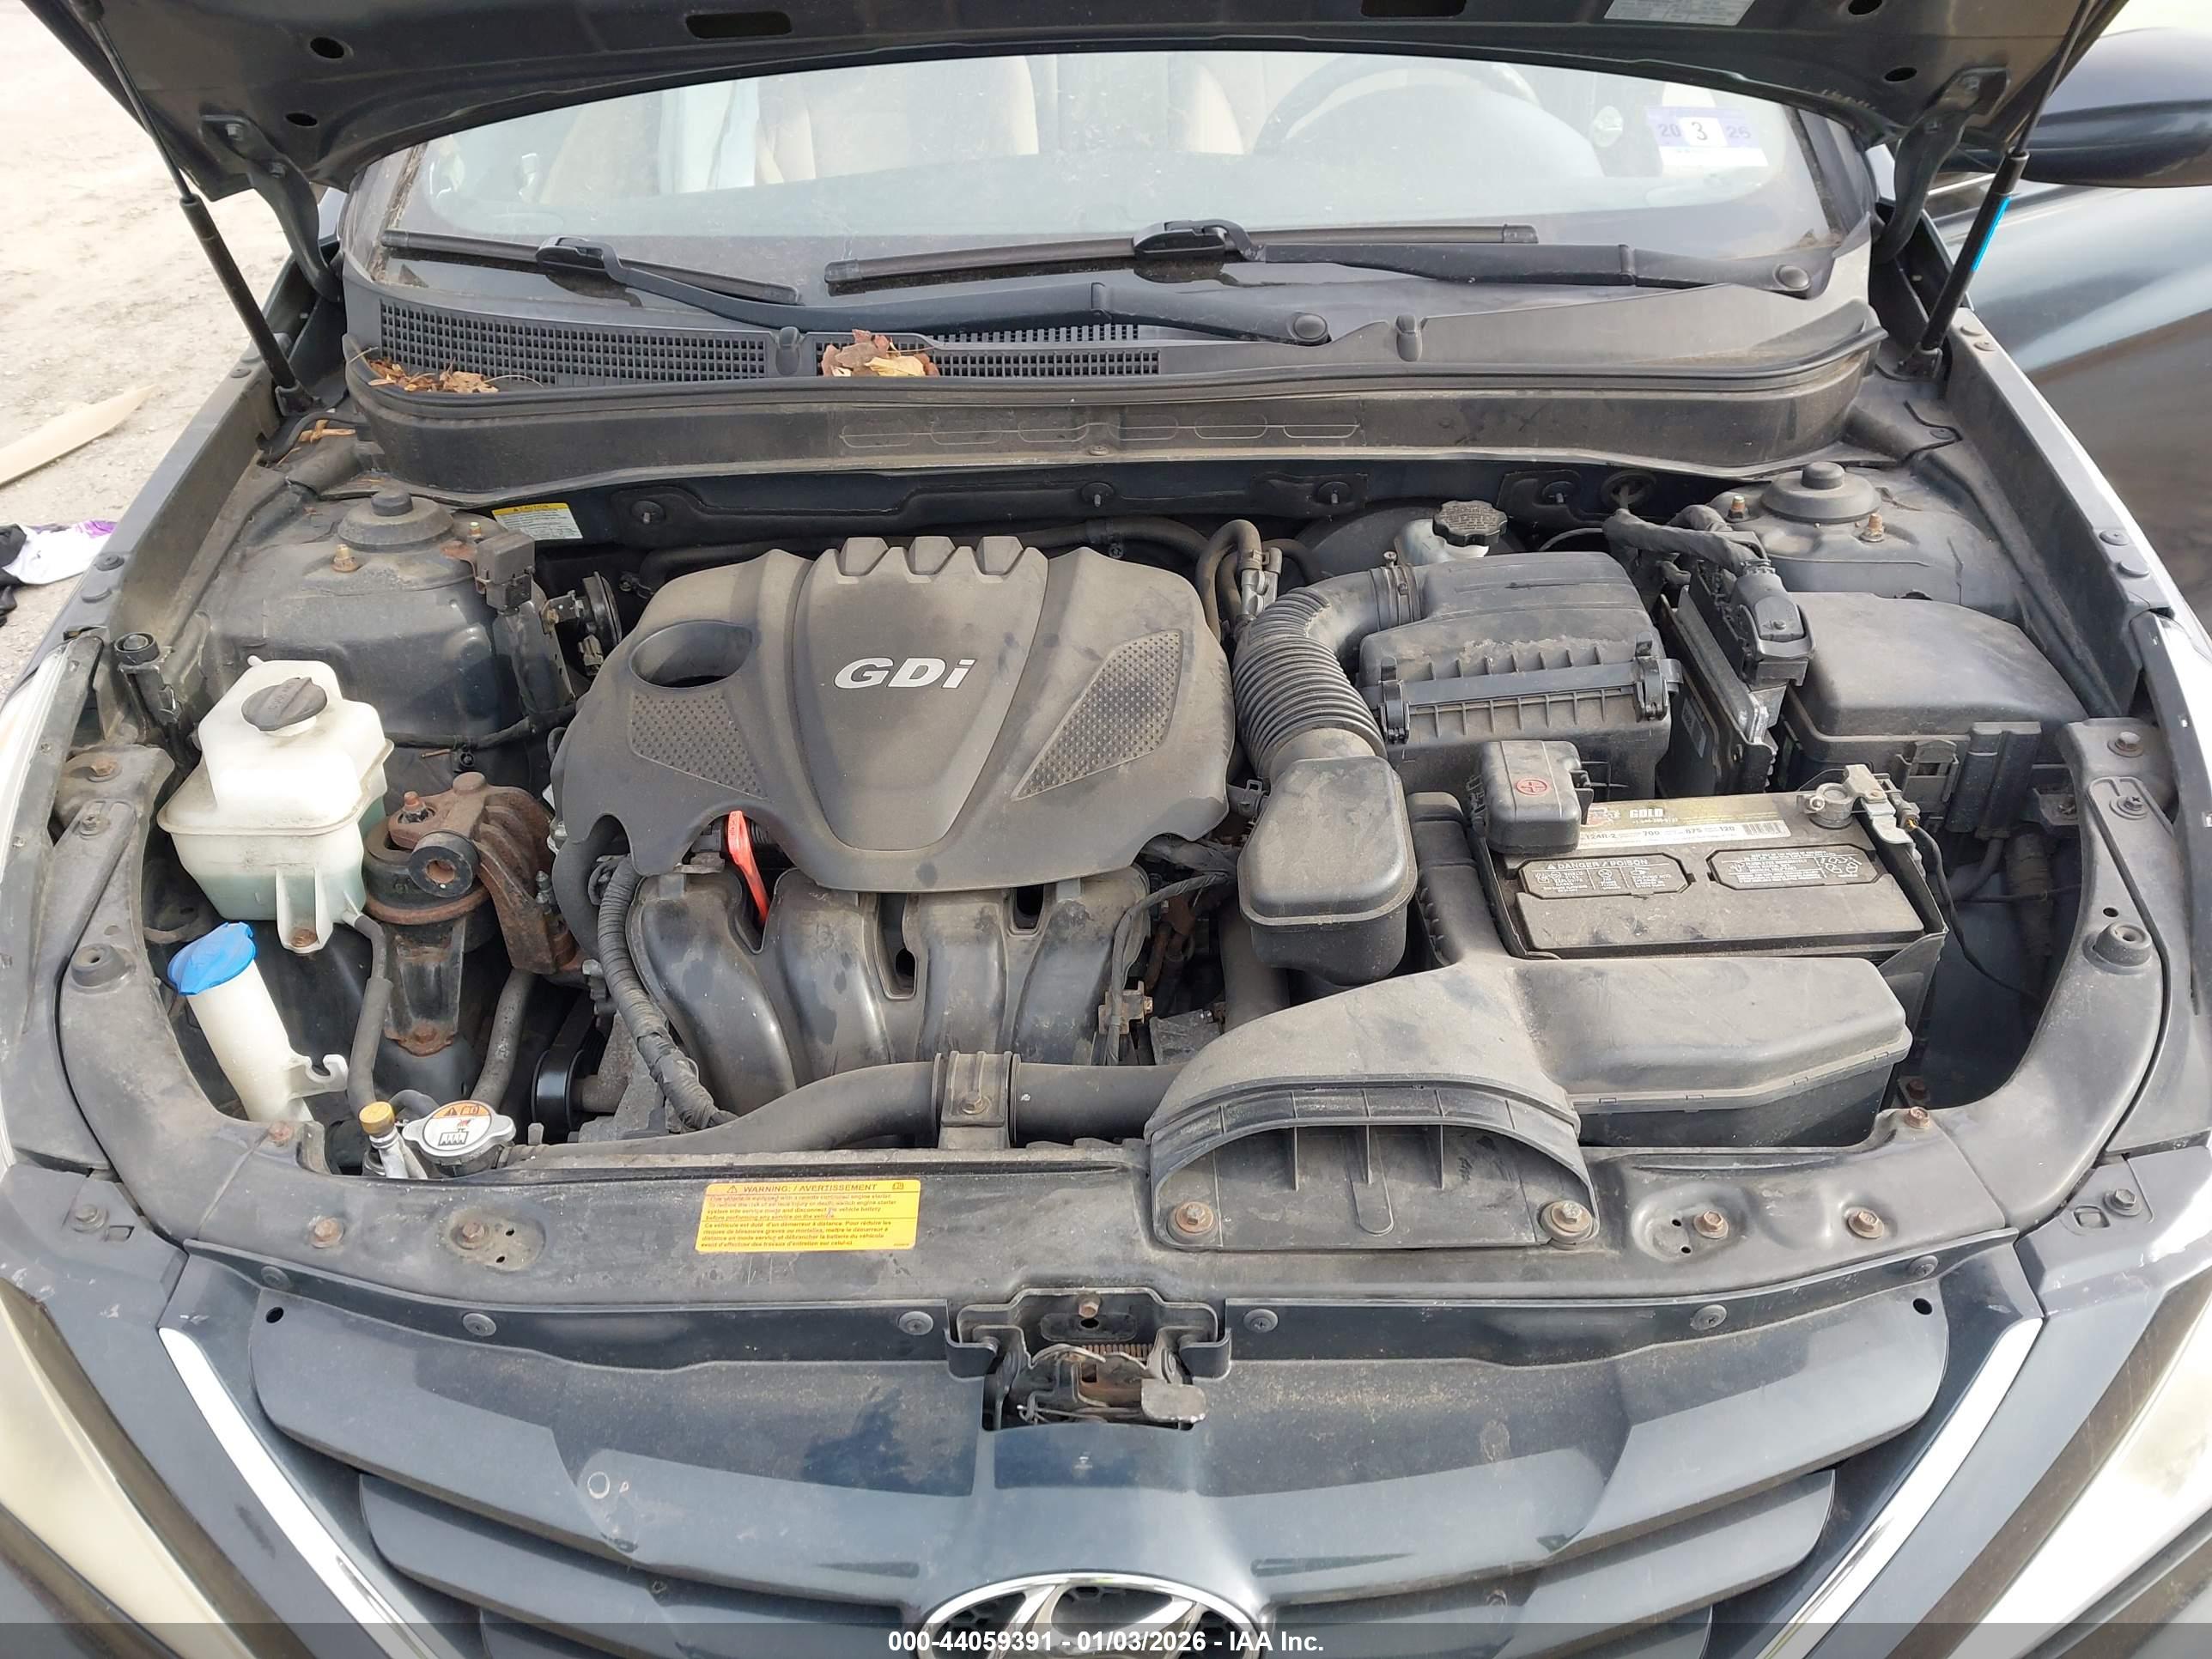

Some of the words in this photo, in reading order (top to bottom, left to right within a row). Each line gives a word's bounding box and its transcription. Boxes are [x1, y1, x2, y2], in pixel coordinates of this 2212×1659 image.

[1658, 124, 1681, 137] 20
[1691, 121, 1708, 141] 3
[834, 657, 978, 689] GDi
[1629, 808, 1663, 818] GOLD
[1558, 861, 1600, 870] DANGER
[1609, 858, 1649, 867] POISON
